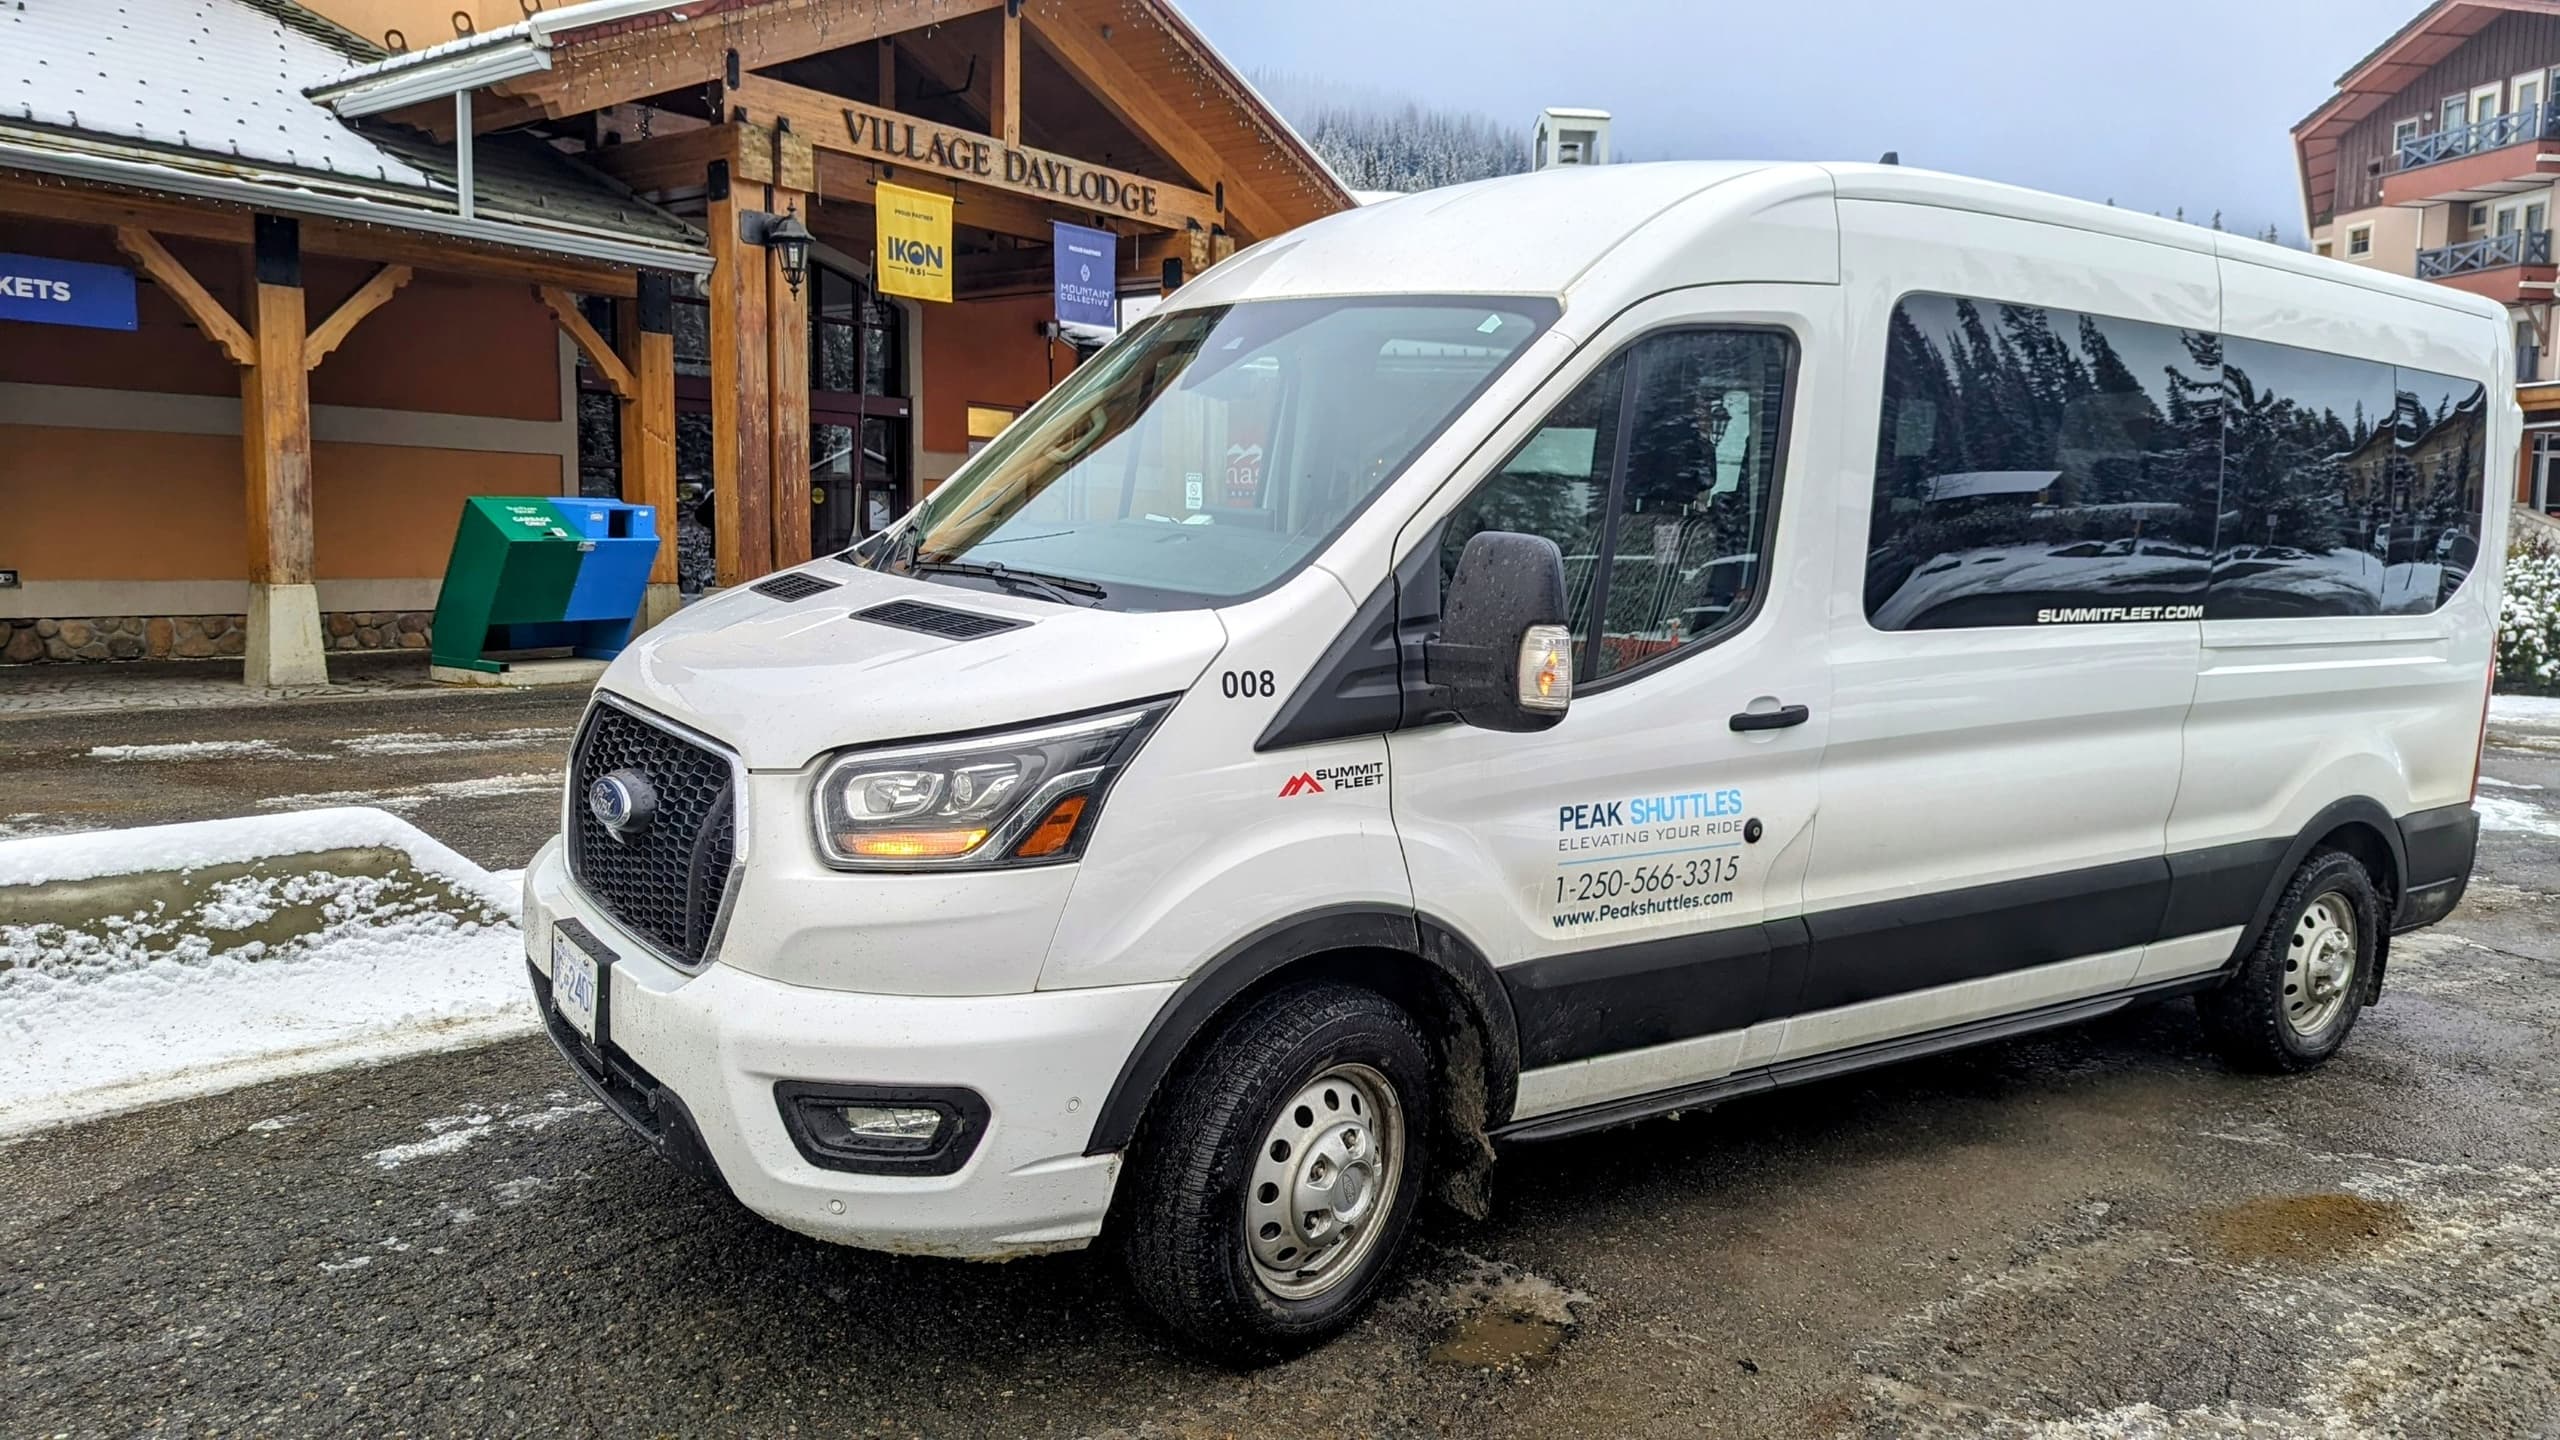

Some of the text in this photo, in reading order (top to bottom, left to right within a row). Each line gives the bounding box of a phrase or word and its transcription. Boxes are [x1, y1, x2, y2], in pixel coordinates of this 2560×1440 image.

[841, 107, 1158, 217] VILLAGE DAYLODGE
[887, 235, 944, 270] IKON
[1060, 283, 1110, 300] MOUNTAIN
[1060, 292, 1109, 307] COLLECTIVE
[2036, 604, 2204, 623] SUMMITFLEET.COM
[1222, 670, 1276, 699] 008
[1316, 762, 1384, 781] SUMMIT
[1334, 773, 1384, 791] FLEET
[1559, 789, 1743, 832] PEAK SHUTTLES
[1558, 819, 1744, 852] ELEVATING YOUR RIDE
[1555, 855, 1740, 904] 1-250-566-3315
[1552, 890, 1734, 928] www.Peakshuttles.com
